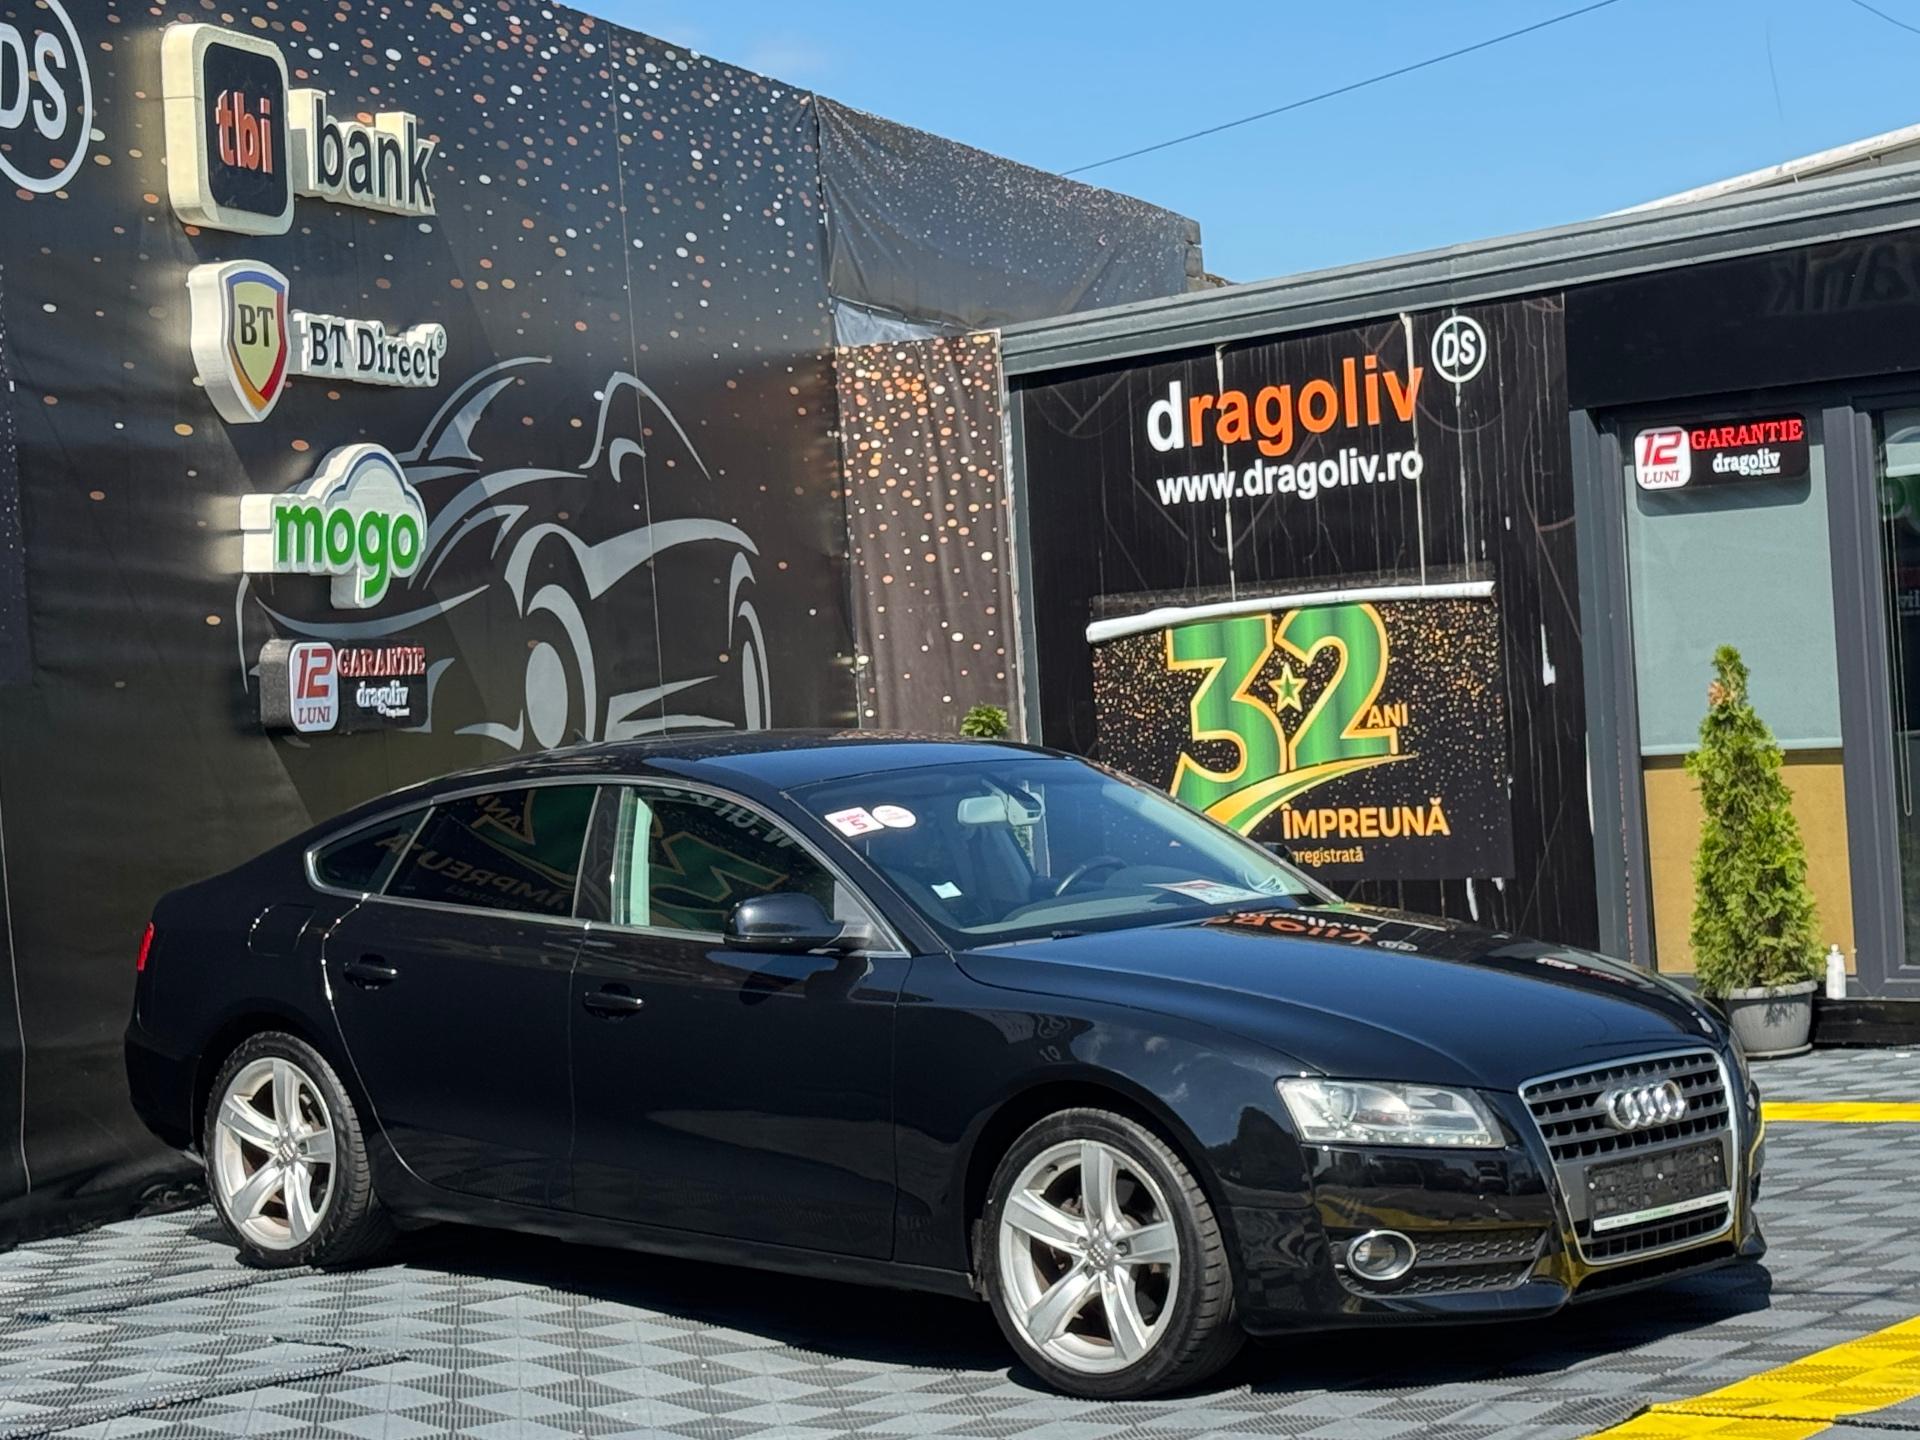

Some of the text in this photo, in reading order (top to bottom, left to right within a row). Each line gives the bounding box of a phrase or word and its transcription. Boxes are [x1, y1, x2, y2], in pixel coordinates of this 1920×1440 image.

[0, 23, 67, 140] DS
[216, 89, 435, 215] tbi bank
[238, 304, 274, 347] BT
[310, 322, 347, 368] BT
[1441, 330, 1476, 367] DS
[1147, 354, 1424, 457] dragoliv
[1642, 431, 1682, 467] 12
[1691, 419, 1803, 450] GARANTIE
[1156, 448, 1424, 506] www.dragoliv.ro
[1644, 470, 1680, 484] LUNI
[1712, 448, 1781, 476] dragoliv
[275, 505, 419, 599] mogo
[297, 648, 334, 699] 12
[337, 647, 426, 678] GARANTIE
[298, 706, 331, 725] LUNI
[356, 680, 409, 714] dragoliv
[1166, 602, 1398, 812] 32
[1366, 703, 1408, 728] ANI
[1281, 797, 1451, 839] ÎMPREUNĂ
